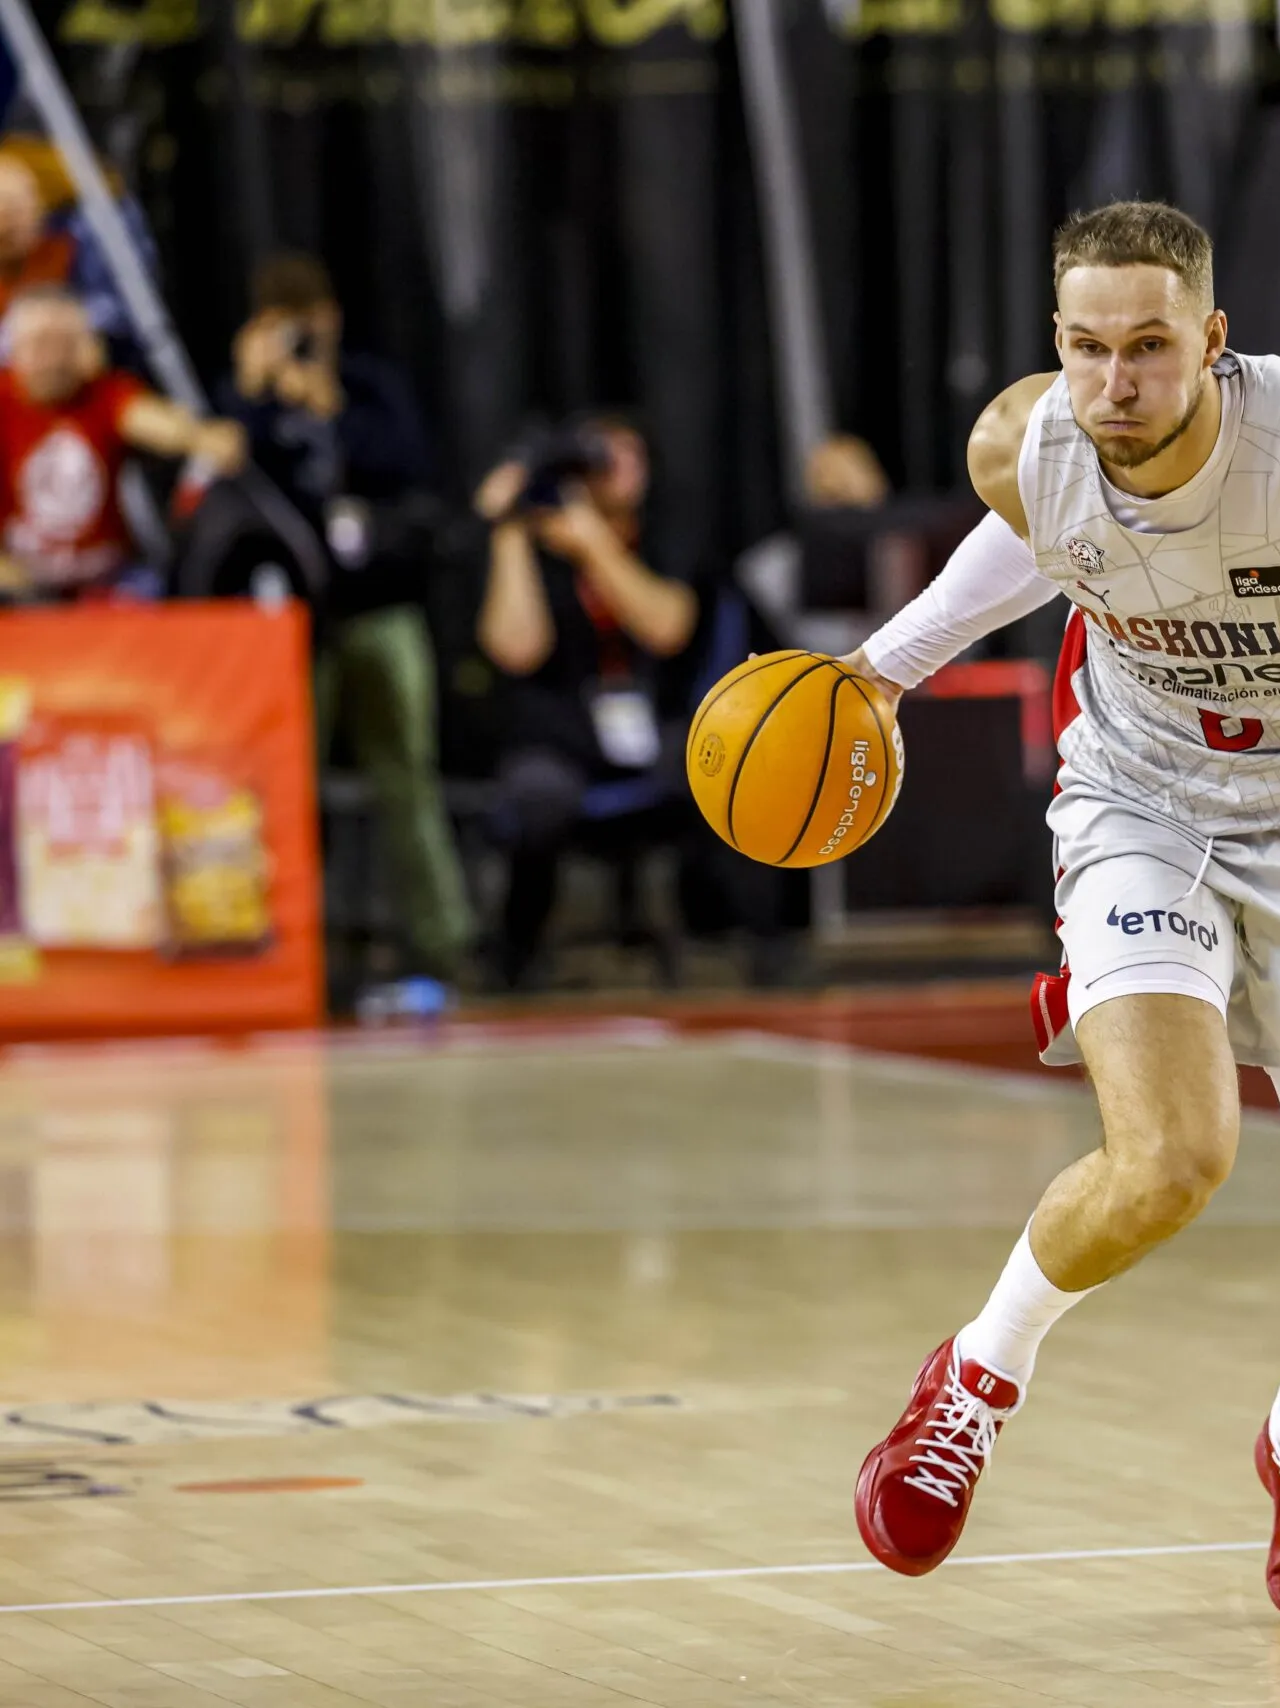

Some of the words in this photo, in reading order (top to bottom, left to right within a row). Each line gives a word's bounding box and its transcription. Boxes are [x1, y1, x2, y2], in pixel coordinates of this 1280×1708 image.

[1235, 576, 1259, 587] liga
[1162, 677, 1258, 704] Climatización
[850, 740, 869, 782] liga
[818, 785, 862, 855] endesa
